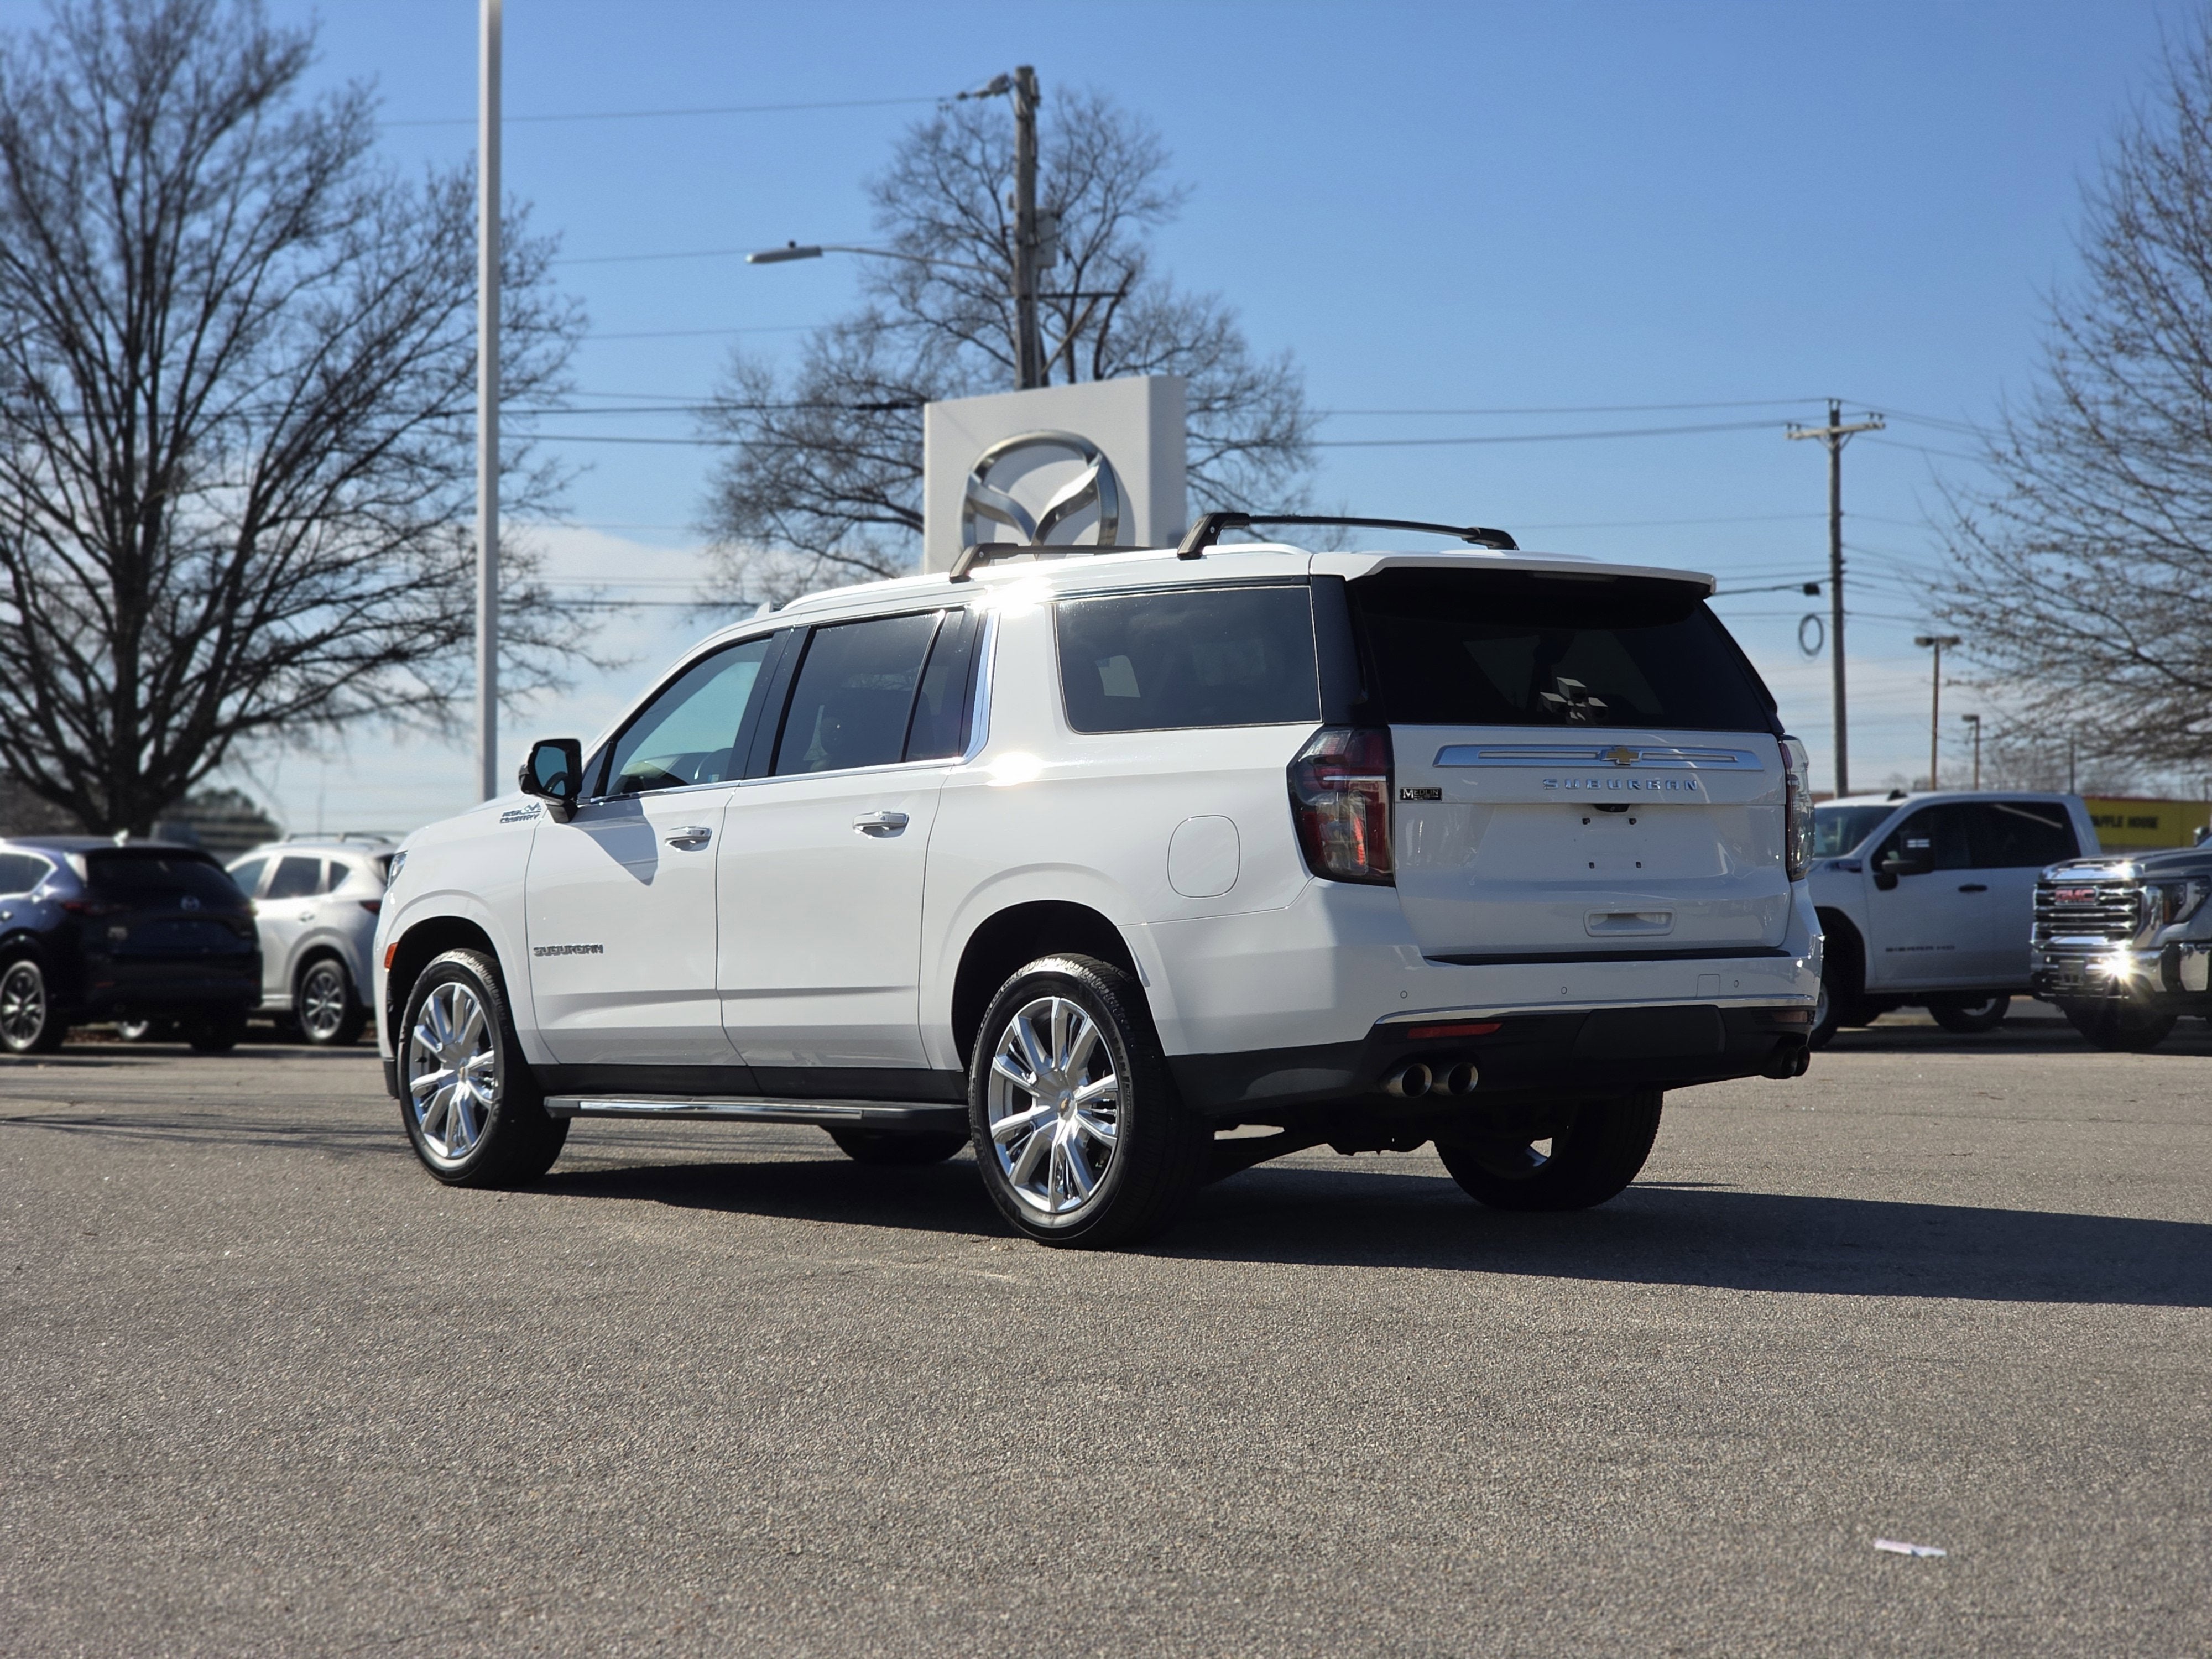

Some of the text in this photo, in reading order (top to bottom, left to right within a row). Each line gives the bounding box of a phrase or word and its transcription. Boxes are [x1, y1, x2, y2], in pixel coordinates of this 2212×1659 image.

[1543, 778, 1698, 791] SUBURBAN
[1403, 789, 1438, 799] MEDLIN
[2055, 889, 2095, 902] GMC
[534, 944, 604, 957] SUBURBAN
